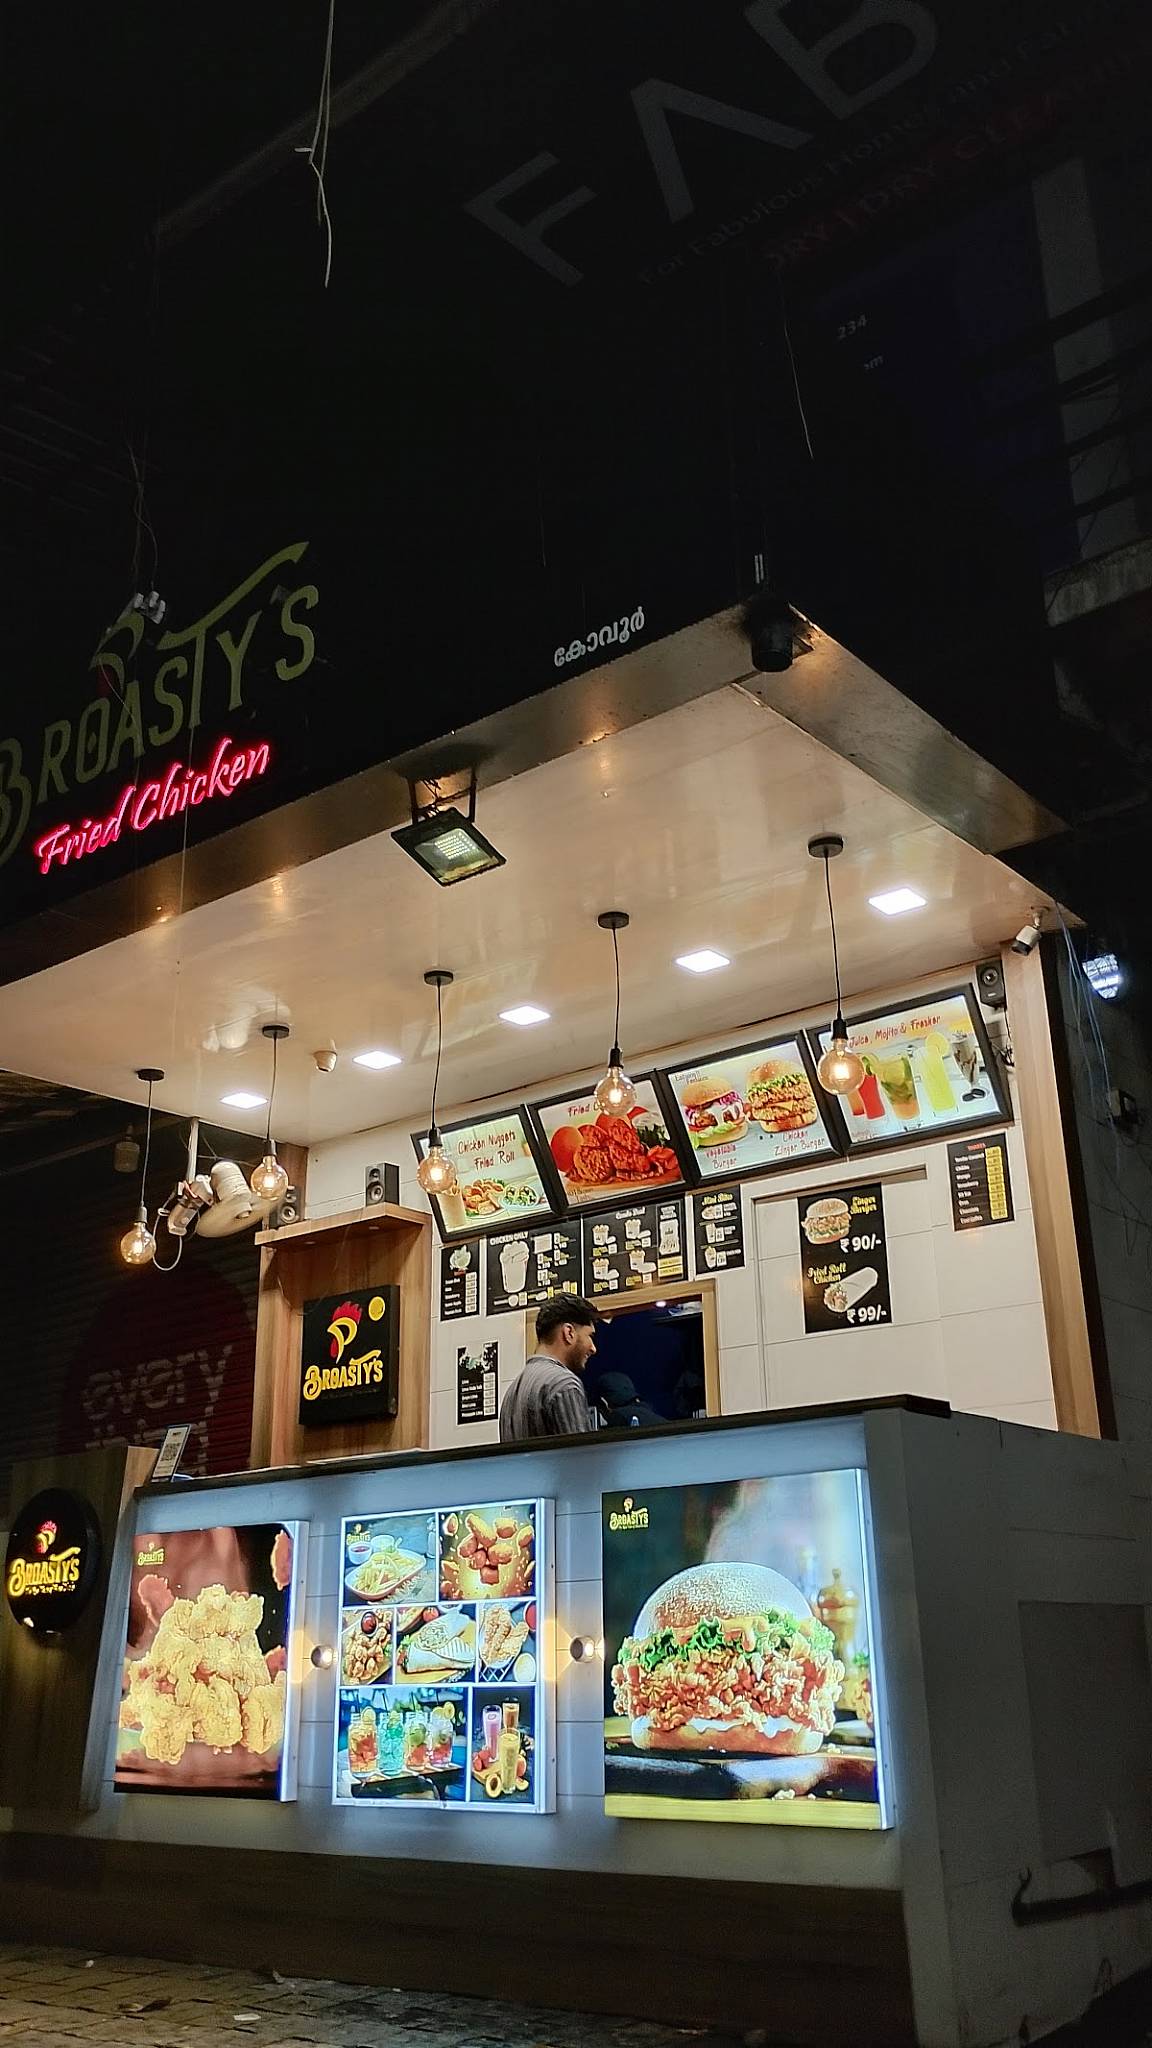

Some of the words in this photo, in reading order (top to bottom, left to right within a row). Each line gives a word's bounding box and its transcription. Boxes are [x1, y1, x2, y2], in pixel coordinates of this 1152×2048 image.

[554, 606, 645, 667] കോവൂർ
[33, 783, 137, 876] Fried
[130, 736, 271, 832] Chicken
[875, 1027, 898, 1041] Mojito
[458, 1140, 486, 1155] Chicken
[488, 1129, 516, 1148] Nuggets
[474, 1156, 494, 1171] Fried
[497, 1150, 515, 1164] Roll
